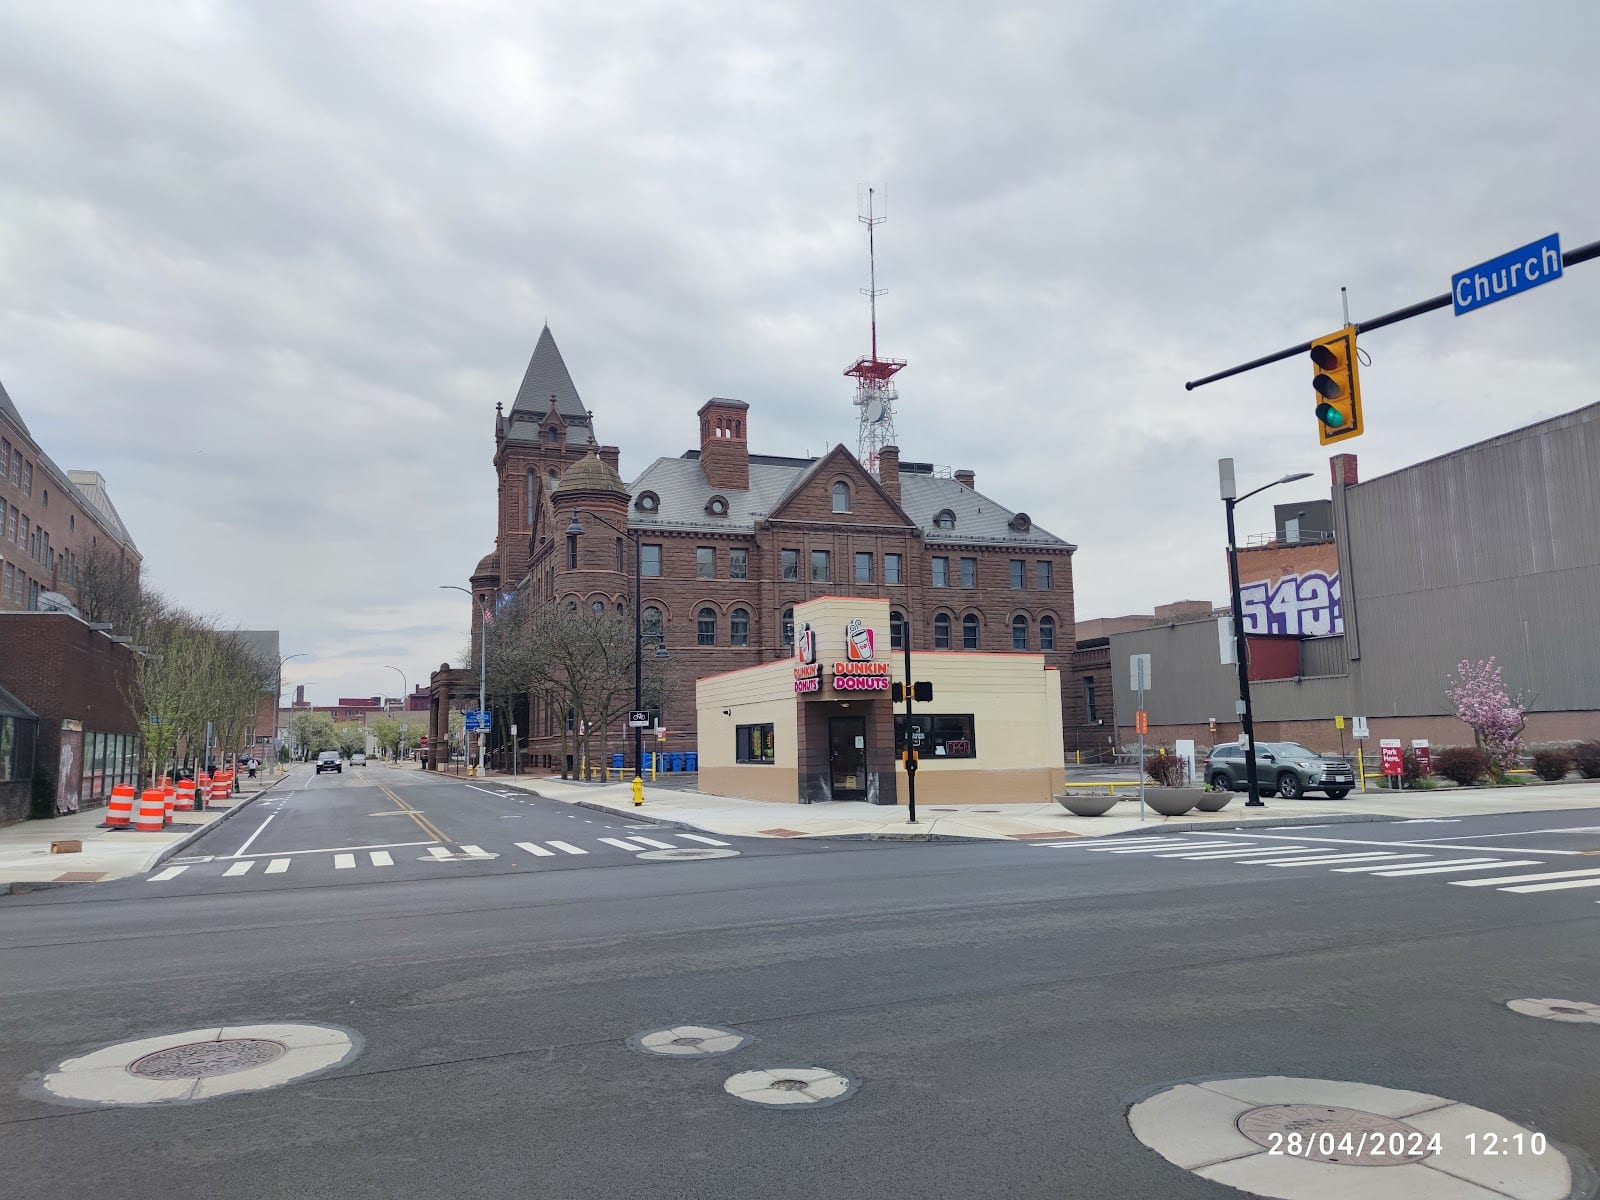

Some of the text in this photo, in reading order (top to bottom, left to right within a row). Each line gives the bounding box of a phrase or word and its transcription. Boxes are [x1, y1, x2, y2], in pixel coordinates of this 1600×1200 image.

[1456, 245, 1559, 307] Church
[794, 680, 817, 693] DONUTS
[836, 677, 889, 689] DONUTS
[947, 742, 970, 754] OPEN
